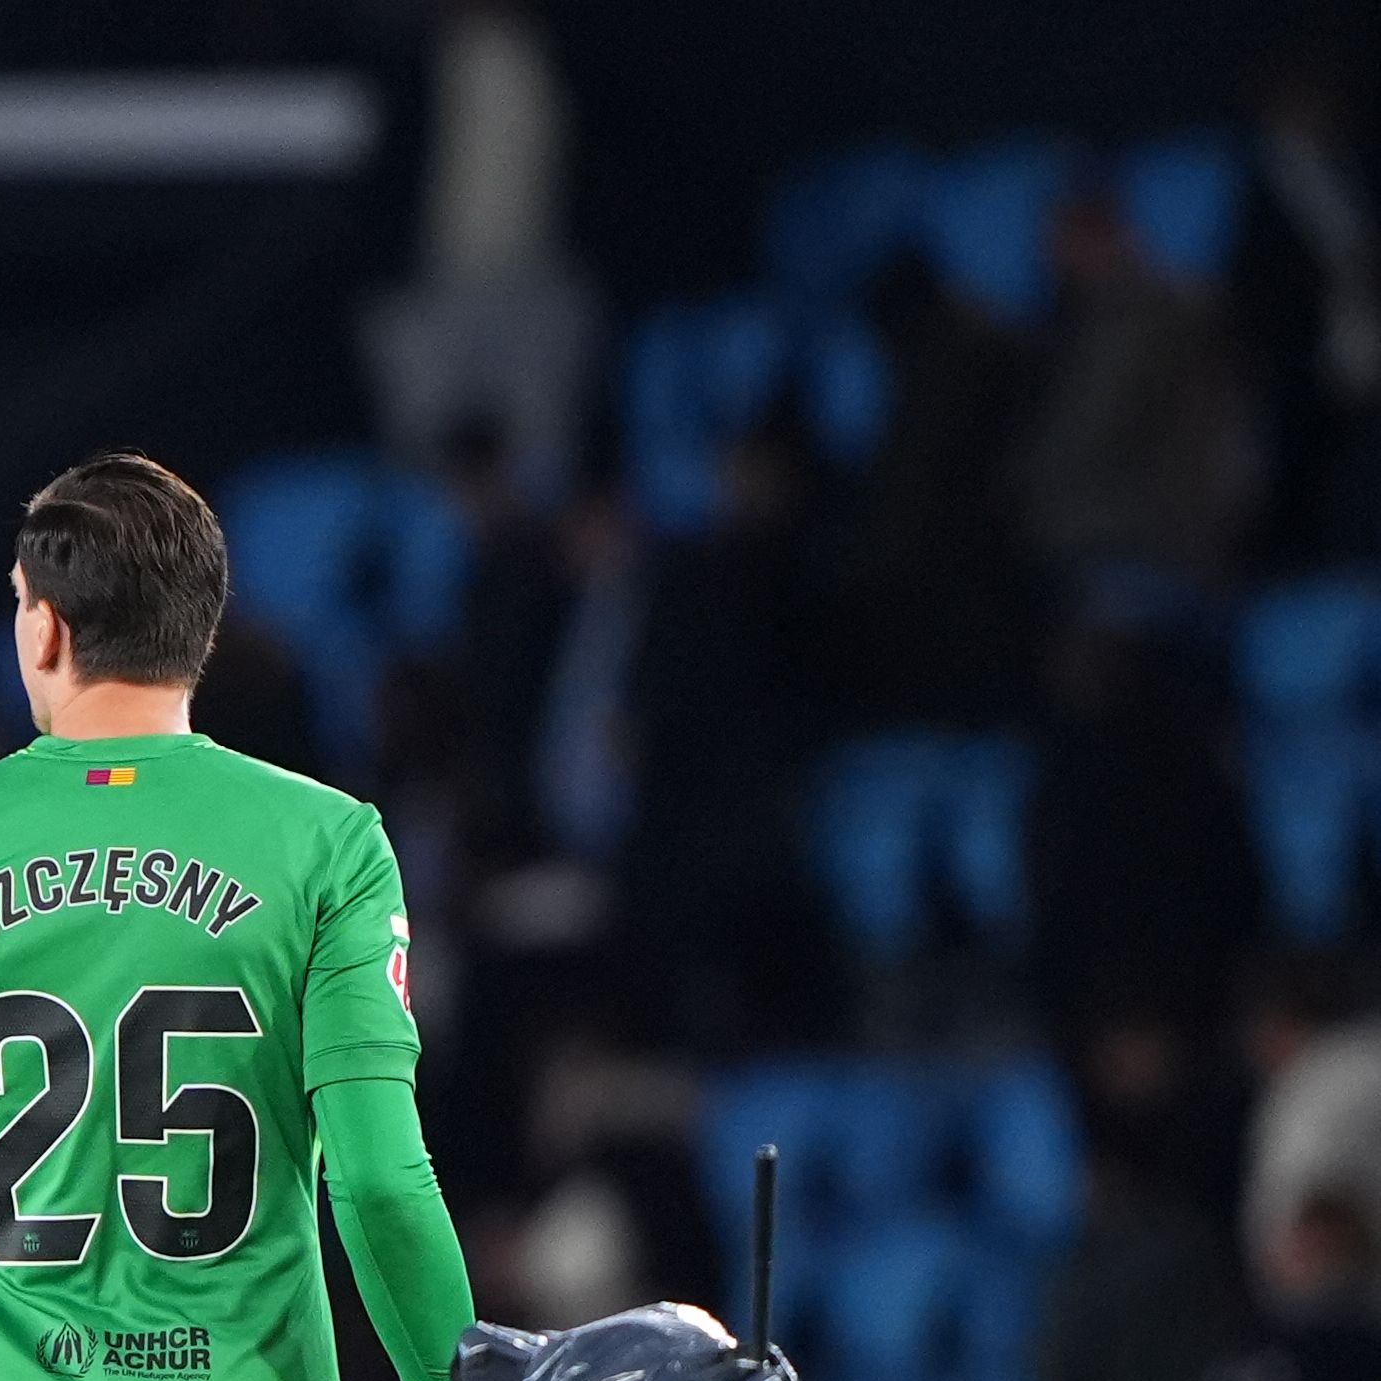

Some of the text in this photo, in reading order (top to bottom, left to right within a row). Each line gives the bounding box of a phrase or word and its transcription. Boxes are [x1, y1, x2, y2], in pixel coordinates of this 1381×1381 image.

[104, 1326, 210, 1351] UNHCR
[102, 1348, 211, 1370] ACNUR
[103, 1368, 119, 1377] The
